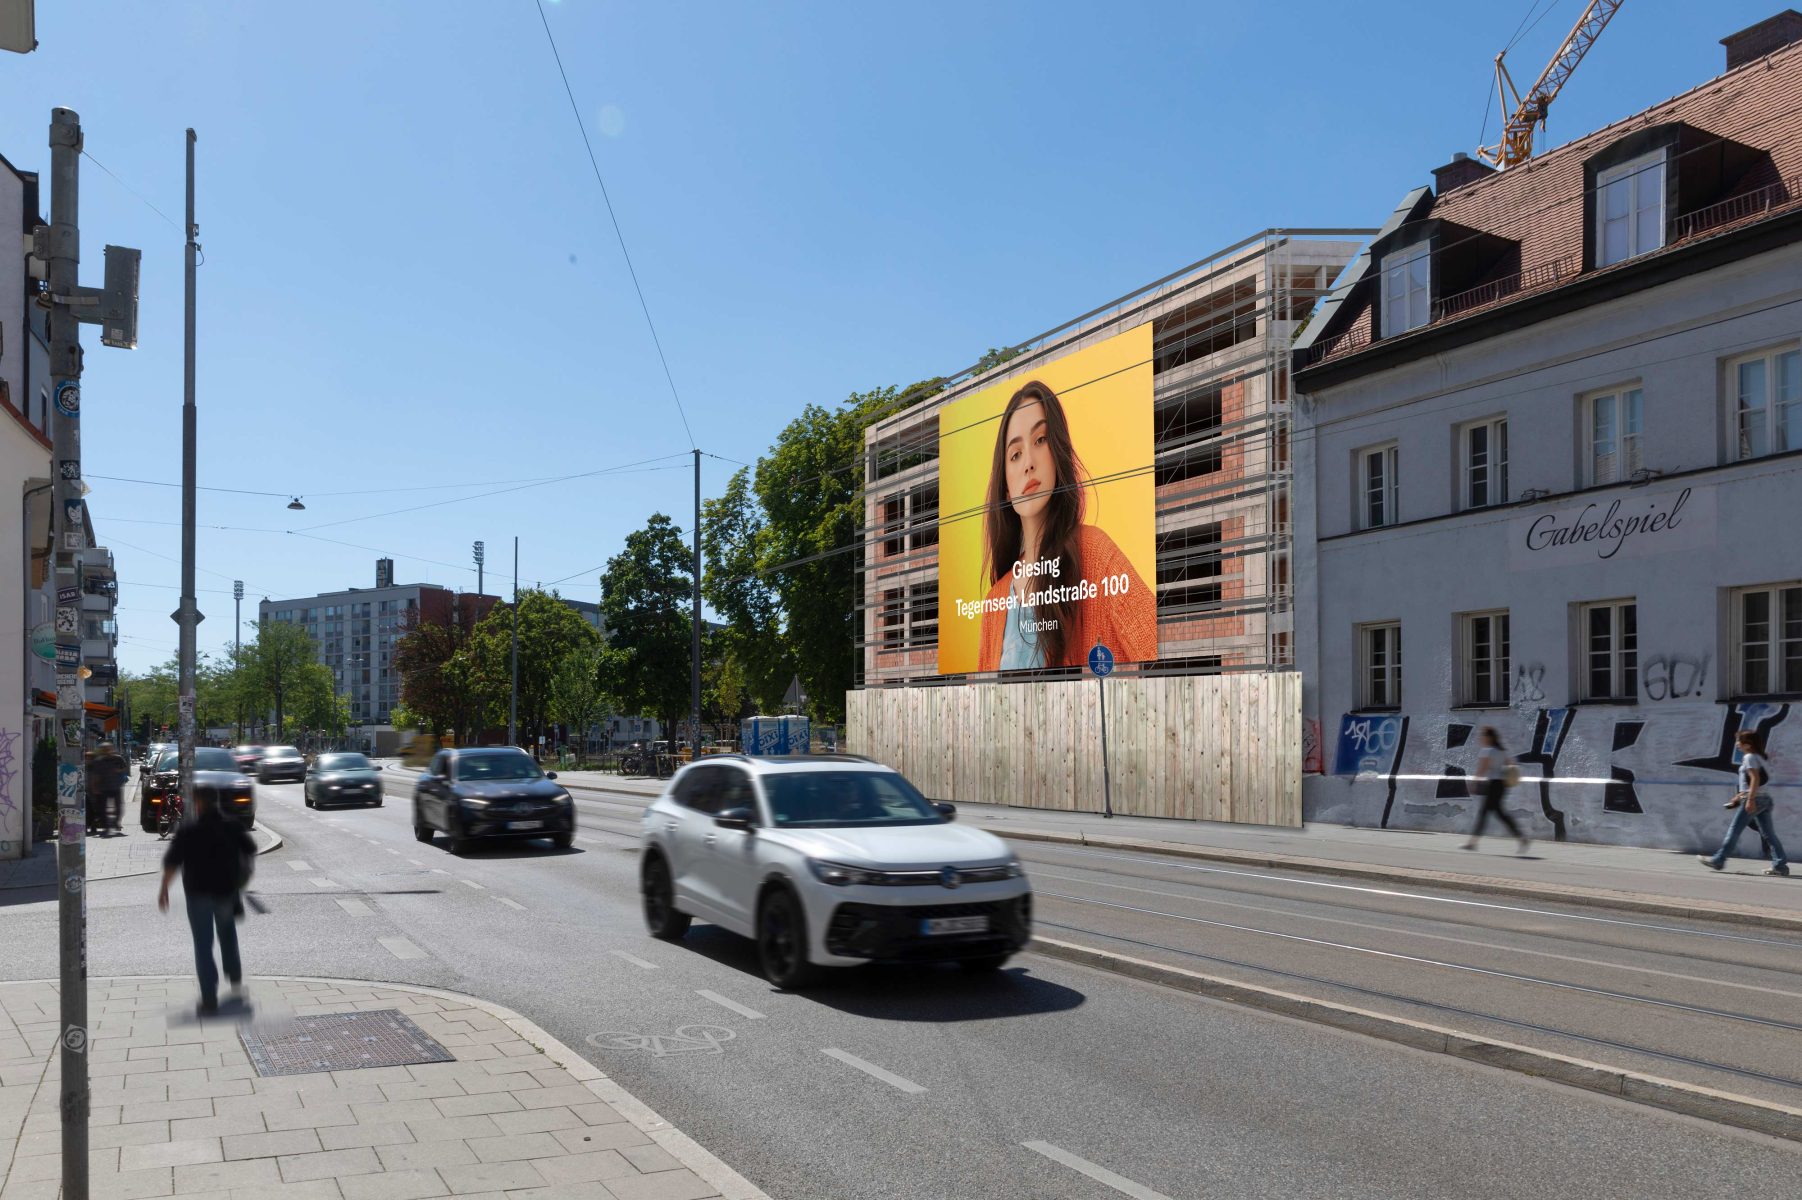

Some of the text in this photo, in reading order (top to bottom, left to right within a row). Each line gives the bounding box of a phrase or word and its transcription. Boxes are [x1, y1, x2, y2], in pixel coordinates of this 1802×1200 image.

[1526, 487, 1691, 559] Gabelspiel
[1012, 556, 1061, 580] Giesing
[956, 573, 1130, 620] Tegernseer Landstraße 100
[1019, 617, 1059, 633] München
